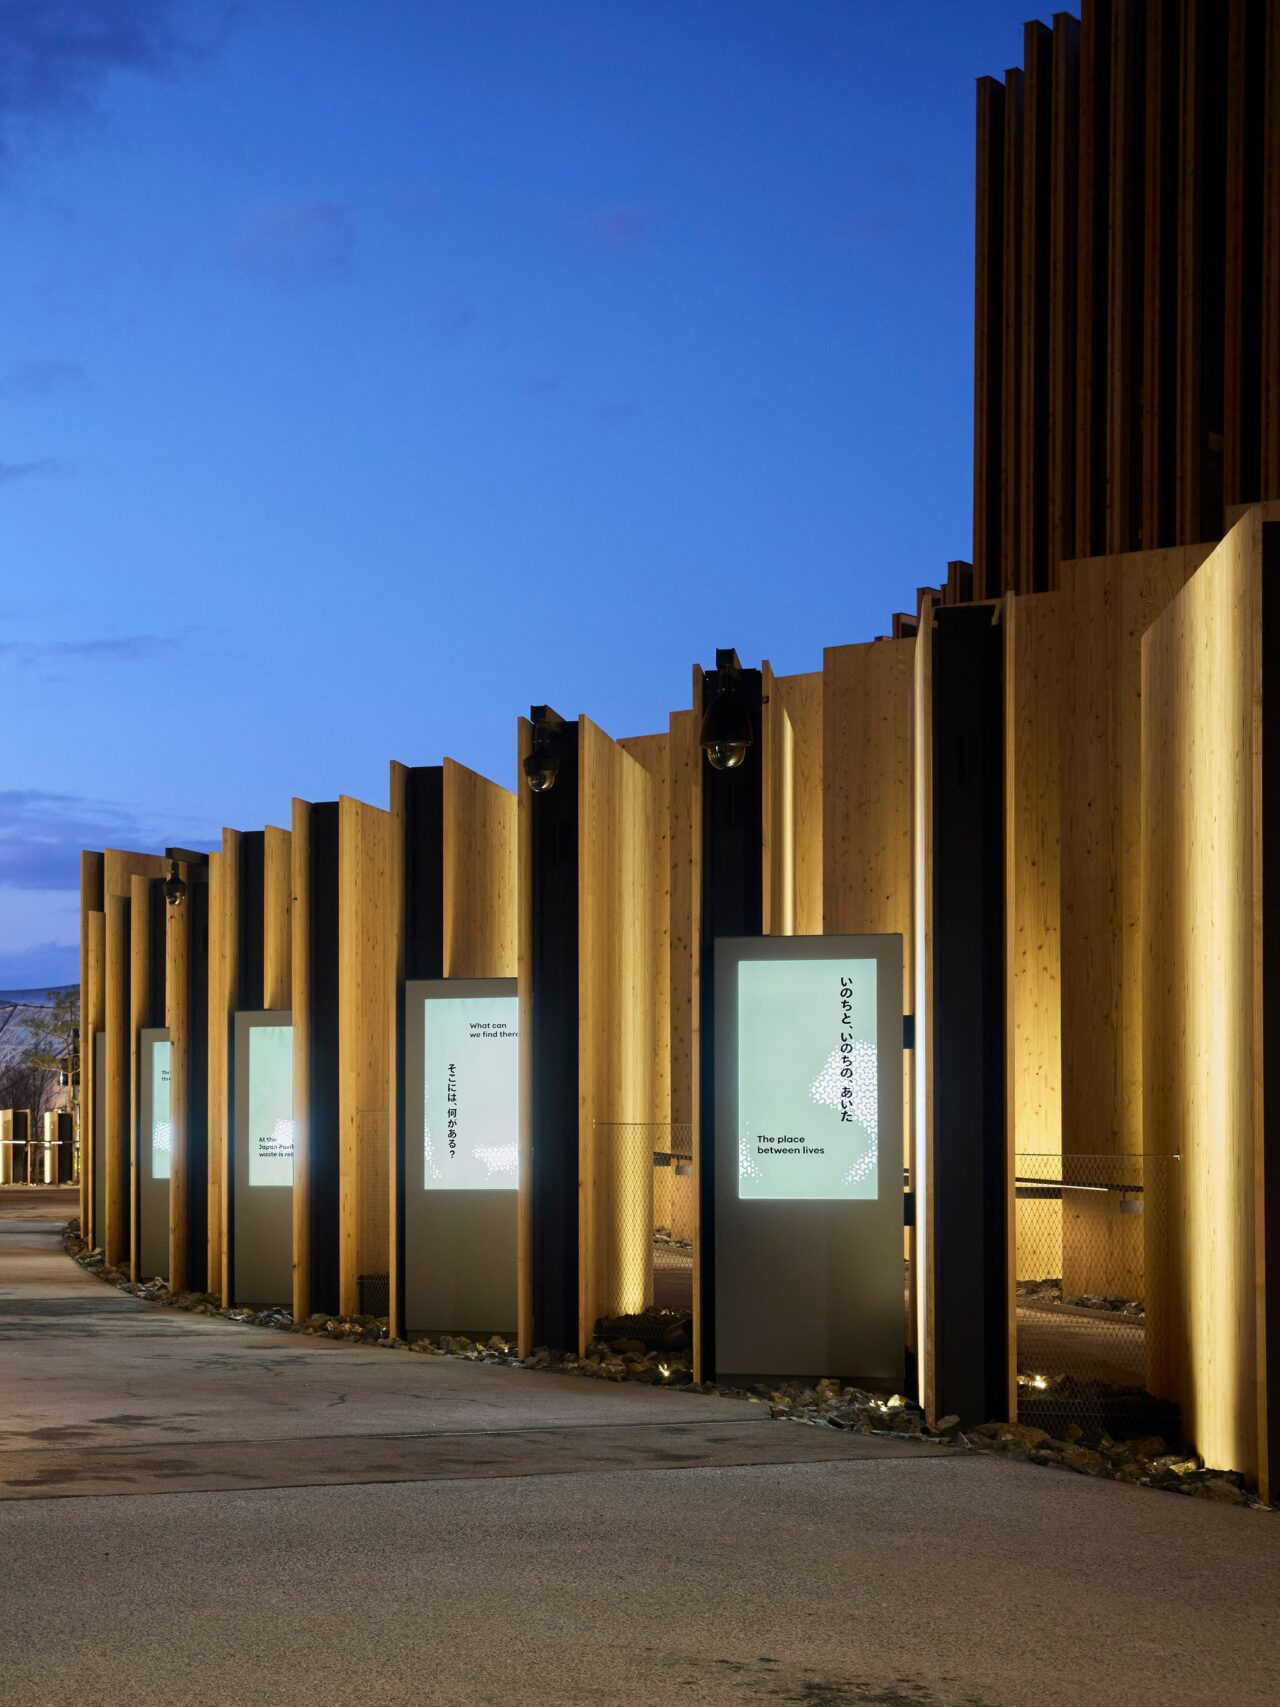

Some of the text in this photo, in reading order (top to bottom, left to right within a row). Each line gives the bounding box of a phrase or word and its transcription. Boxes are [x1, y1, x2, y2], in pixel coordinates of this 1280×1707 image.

[482, 1030, 498, 1038] find
[757, 1135, 806, 1144] The place
[757, 1146, 825, 1154] between lives
